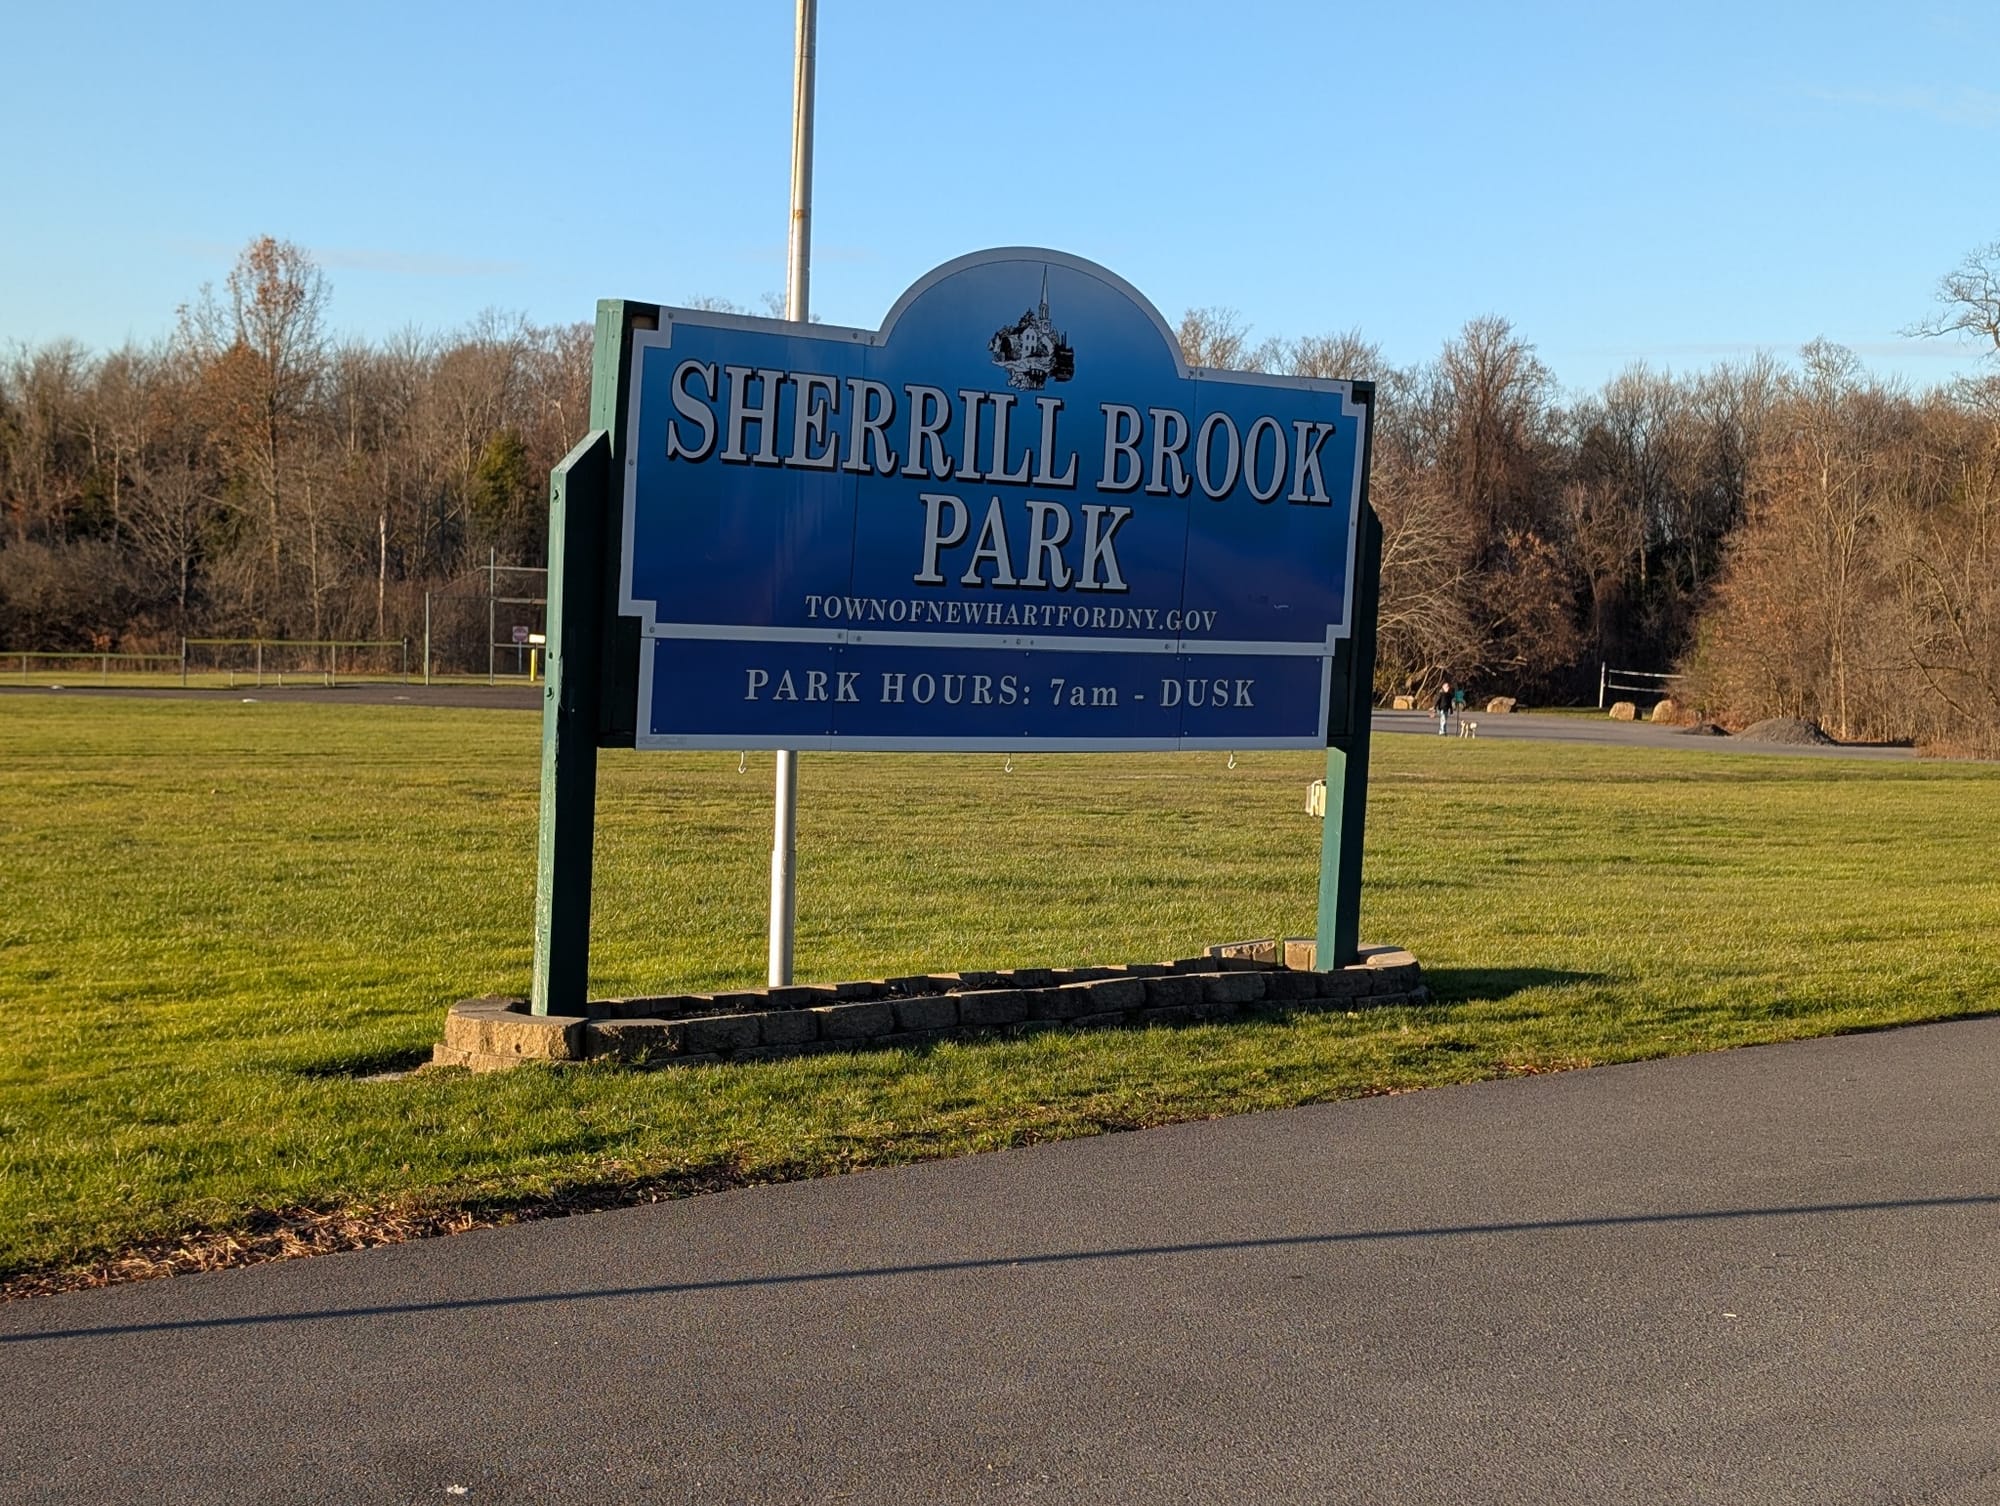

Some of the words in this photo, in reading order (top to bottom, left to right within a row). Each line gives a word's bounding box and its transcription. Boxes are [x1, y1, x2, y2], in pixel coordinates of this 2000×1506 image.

[667, 360, 1077, 489] SHERRILL
[1097, 403, 1334, 504] BROOK
[914, 494, 1131, 591] PARK
[805, 595, 1217, 632] TOWNOFNEWHARTFORDNY.GOV
[744, 669, 861, 703] PARK
[880, 673, 1030, 705] HOURS:
[1050, 678, 1119, 707] 7am
[1160, 679, 1255, 708] DUSK
